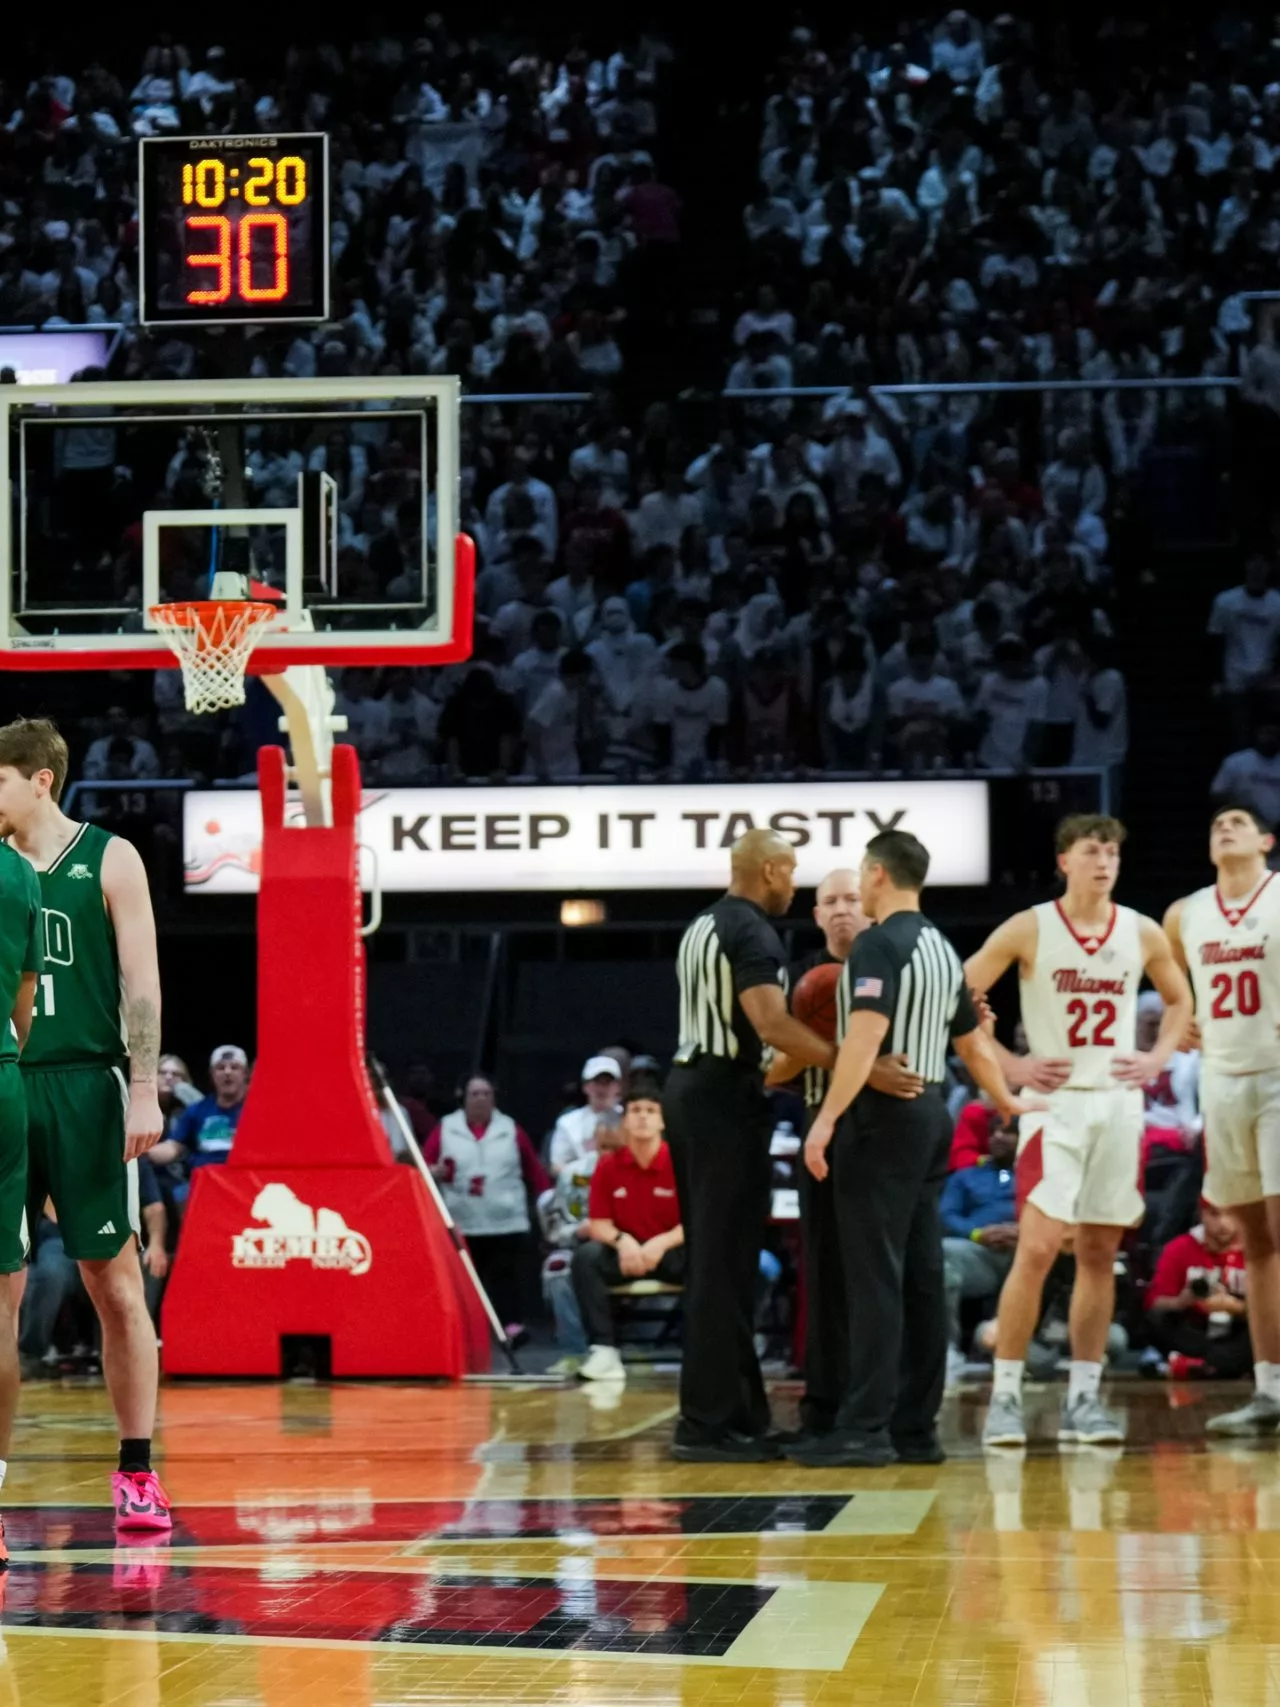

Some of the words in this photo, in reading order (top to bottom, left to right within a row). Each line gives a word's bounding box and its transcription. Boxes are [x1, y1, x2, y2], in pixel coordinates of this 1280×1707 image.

[189, 137, 278, 149] DAKTRONICS
[182, 156, 306, 207] 10:20
[186, 213, 289, 304] 30
[392, 813, 570, 851] KEEP
[597, 812, 656, 849] IT
[1199, 934, 1269, 966] Miami
[1052, 967, 1129, 996] Miami
[1211, 969, 1261, 1020] 20
[1066, 999, 1117, 1047] 22
